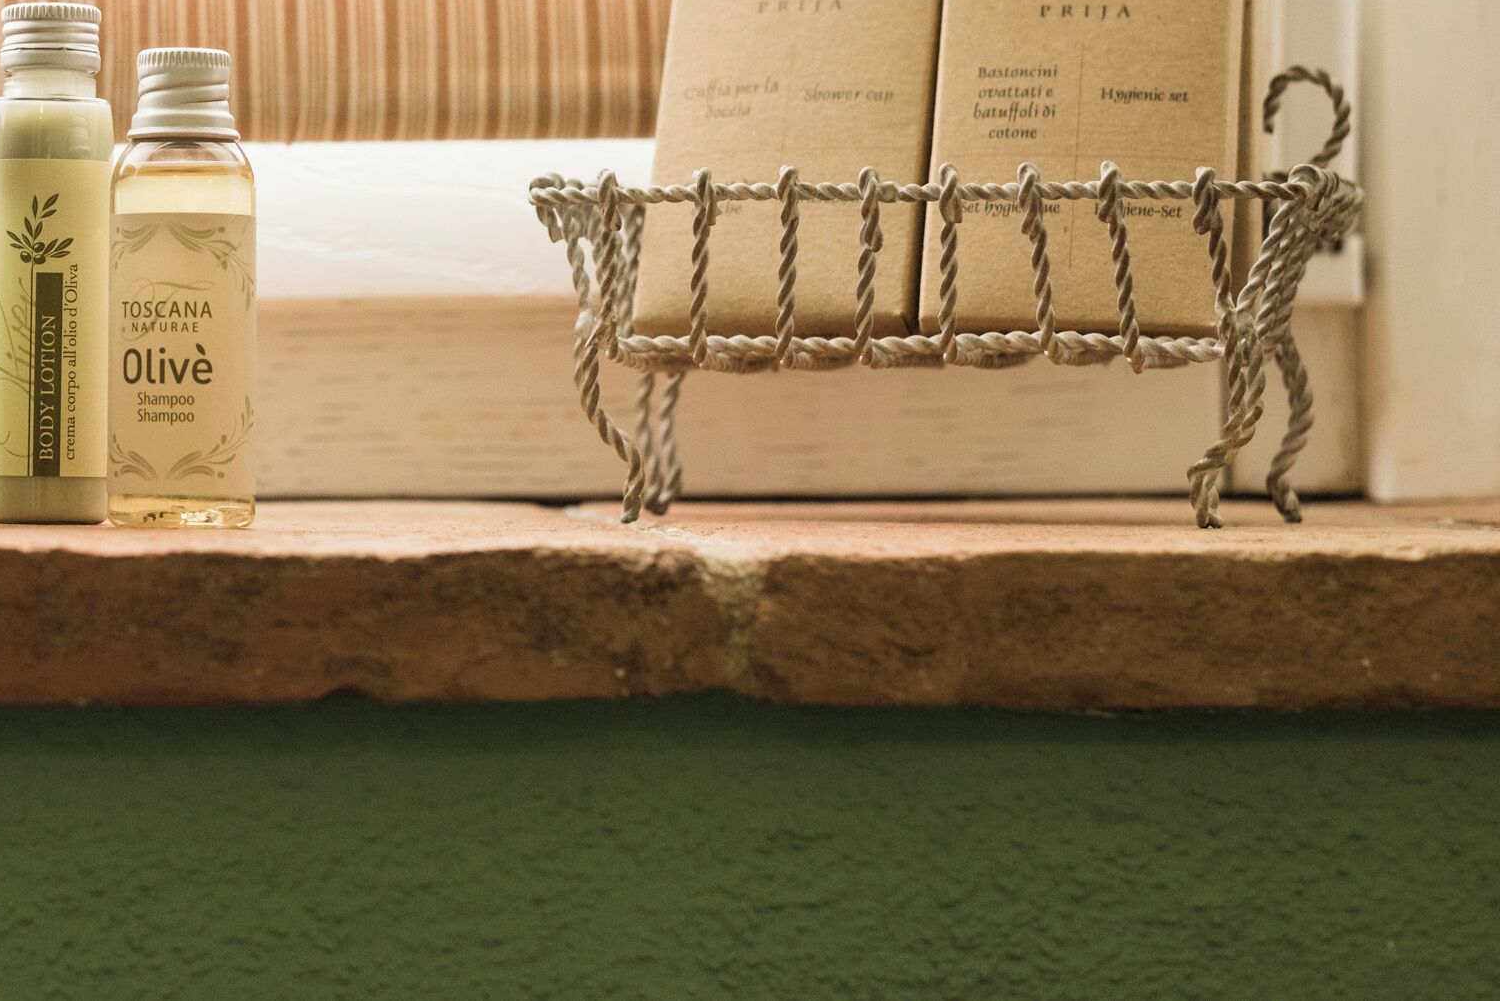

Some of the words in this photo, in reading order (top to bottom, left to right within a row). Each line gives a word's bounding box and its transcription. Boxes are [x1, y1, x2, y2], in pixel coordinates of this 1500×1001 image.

[1040, 4, 1131, 20] PRIJA
[978, 64, 1058, 79] Bastoncini
[978, 85, 1042, 99] ovattati
[1101, 87, 1165, 105] Hygienic
[1168, 91, 1190, 104] set
[973, 101, 1039, 123] batuffoli
[988, 127, 1038, 139] cotone
[64, 263, 78, 317] d'Oliva
[121, 301, 213, 319] TOSCANA
[131, 321, 199, 333] NATURAE
[63, 319, 77, 367] all'olio
[40, 314, 57, 396] LOTION
[122, 342, 213, 385] Olivè
[65, 370, 80, 414] corpo
[136, 391, 196, 408] Shampoo
[136, 408, 196, 426] Shampoo
[39, 402, 55, 462] BODY
[65, 416, 76, 462] crema
